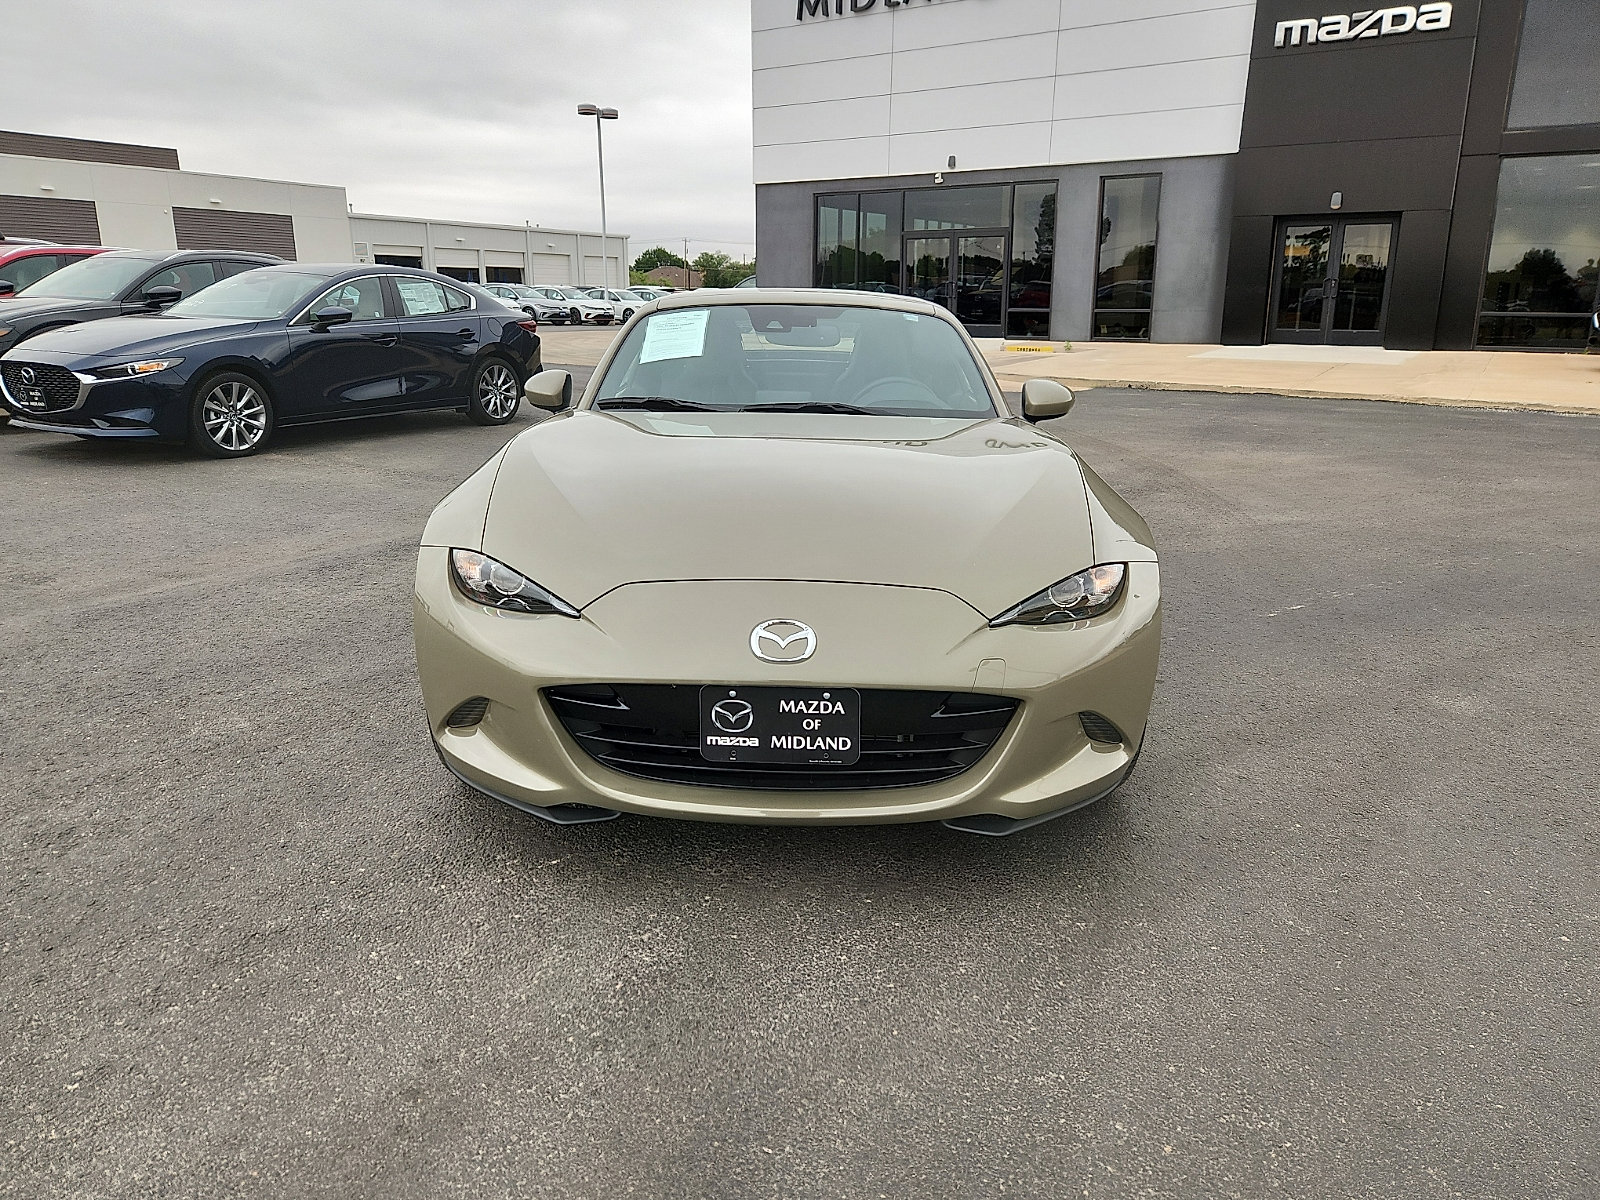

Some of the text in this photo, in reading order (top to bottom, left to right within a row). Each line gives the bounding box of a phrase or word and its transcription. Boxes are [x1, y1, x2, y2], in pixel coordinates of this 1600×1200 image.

[1274, 2, 1453, 47] mazda
[779, 700, 845, 715] MAZDA
[802, 719, 822, 730] OF
[706, 736, 760, 747] mazda
[770, 735, 852, 751] MIDLAND
